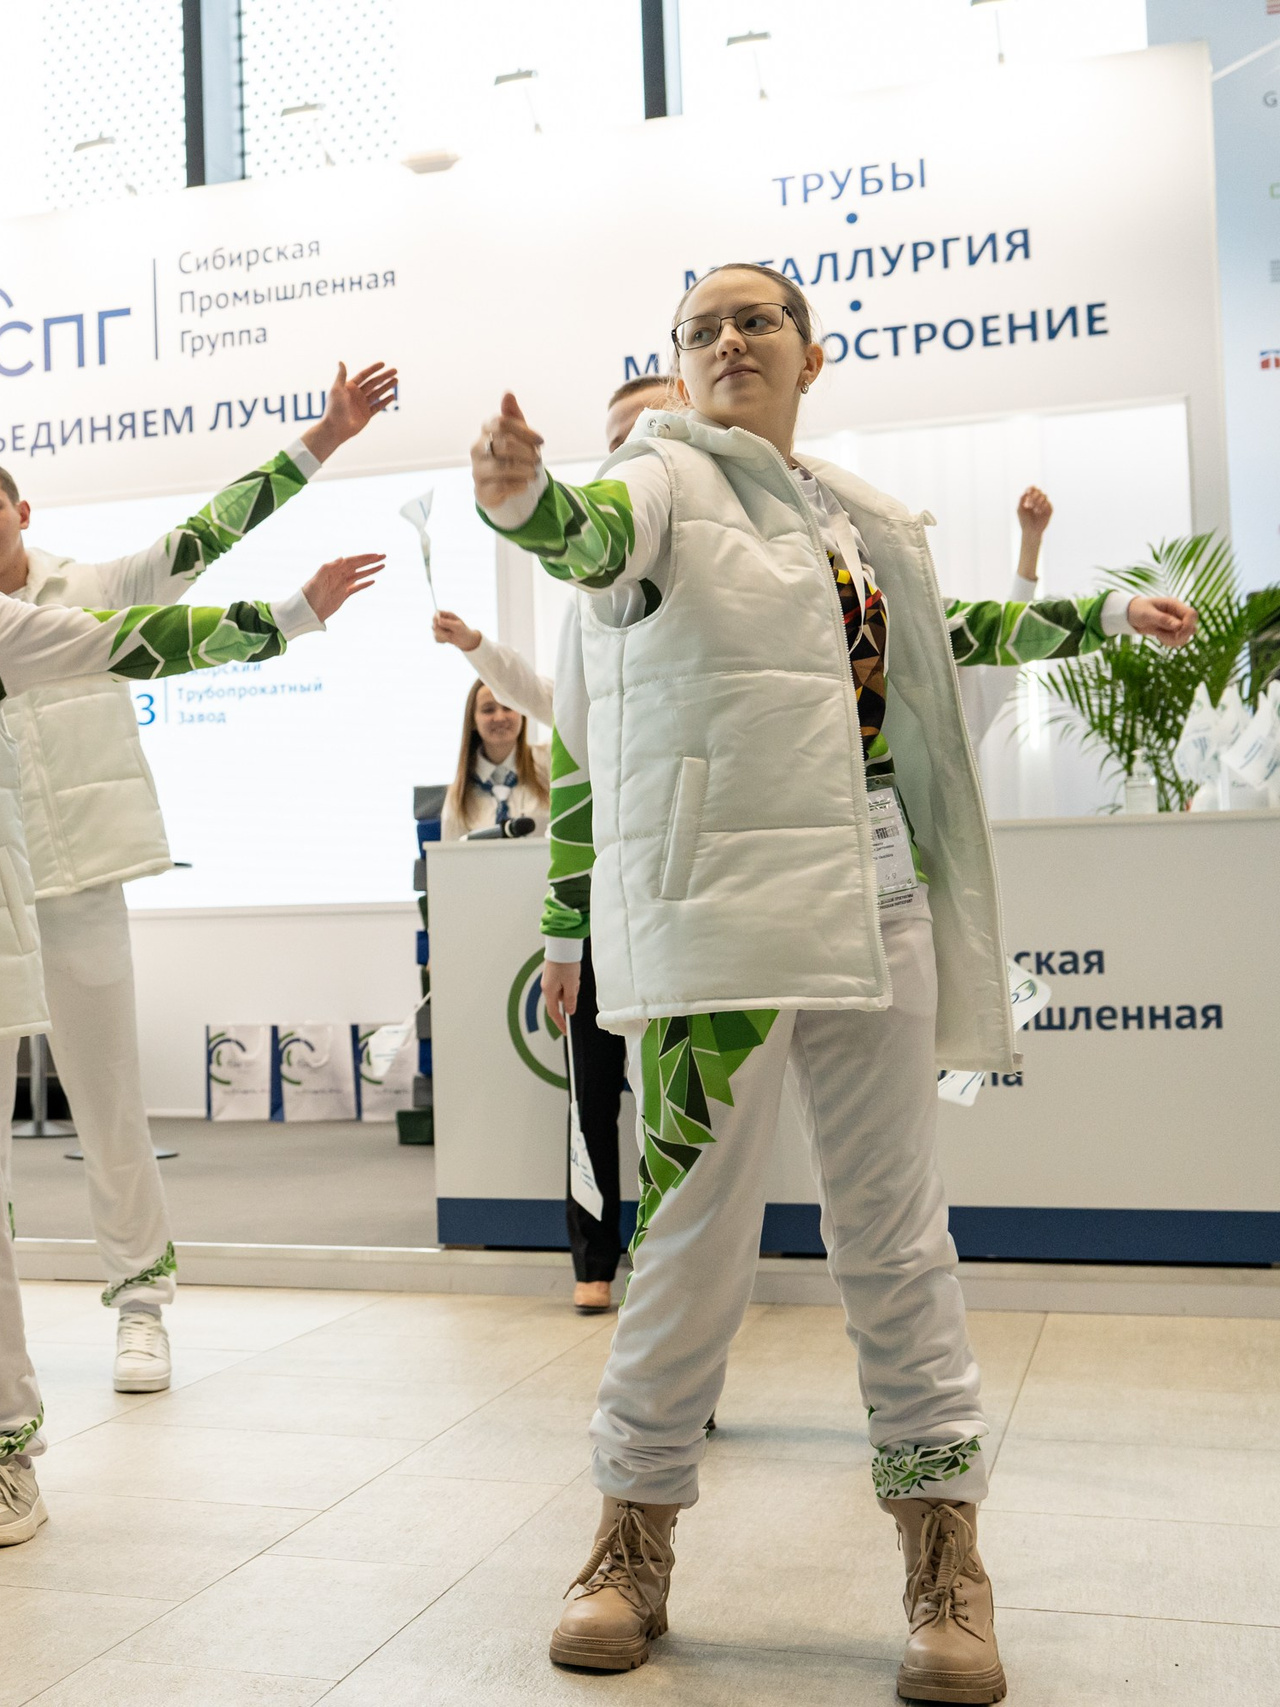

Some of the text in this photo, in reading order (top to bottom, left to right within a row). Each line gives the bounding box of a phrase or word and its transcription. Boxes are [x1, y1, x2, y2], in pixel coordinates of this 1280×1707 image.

[772, 158, 927, 206] ТРУБЫ
[178, 240, 322, 276] Сибирская
[684, 227, 1032, 291] АЛЛУРГИЯ
[179, 269, 397, 317] Промышленная
[179, 325, 269, 356] Группа
[624, 302, 1110, 381] МОСТРОЕНИЕ
[208, 383, 401, 432] ЛУЧШ!
[177, 676, 323, 702] Трубопрокатный
[178, 710, 227, 725] Завод
[1022, 1003, 1224, 1031] шленная
